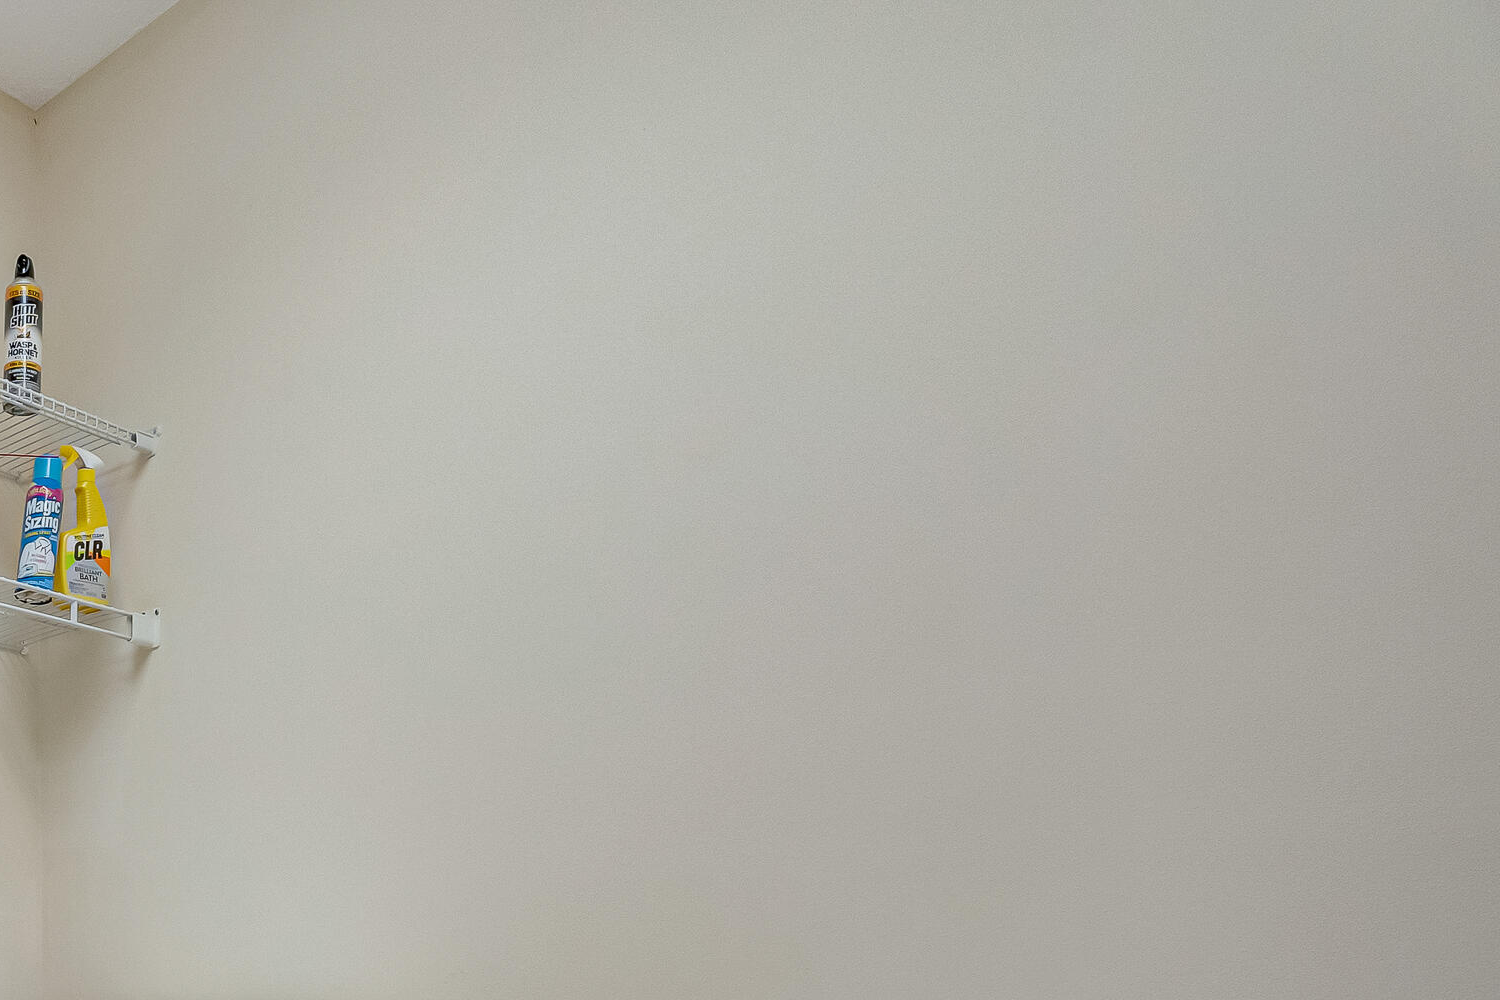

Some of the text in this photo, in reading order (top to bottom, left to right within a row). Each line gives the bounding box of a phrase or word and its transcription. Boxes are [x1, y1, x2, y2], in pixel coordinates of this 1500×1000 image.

[13, 304, 36, 317] HOT
[10, 315, 39, 328] SHOT
[9, 341, 33, 350] WASP
[8, 348, 39, 359] HORNET
[26, 496, 61, 517] Magic
[24, 516, 59, 534] Sizing
[74, 540, 104, 562] CLR
[74, 566, 103, 577] BRILLIANT
[79, 573, 98, 583] BATH
